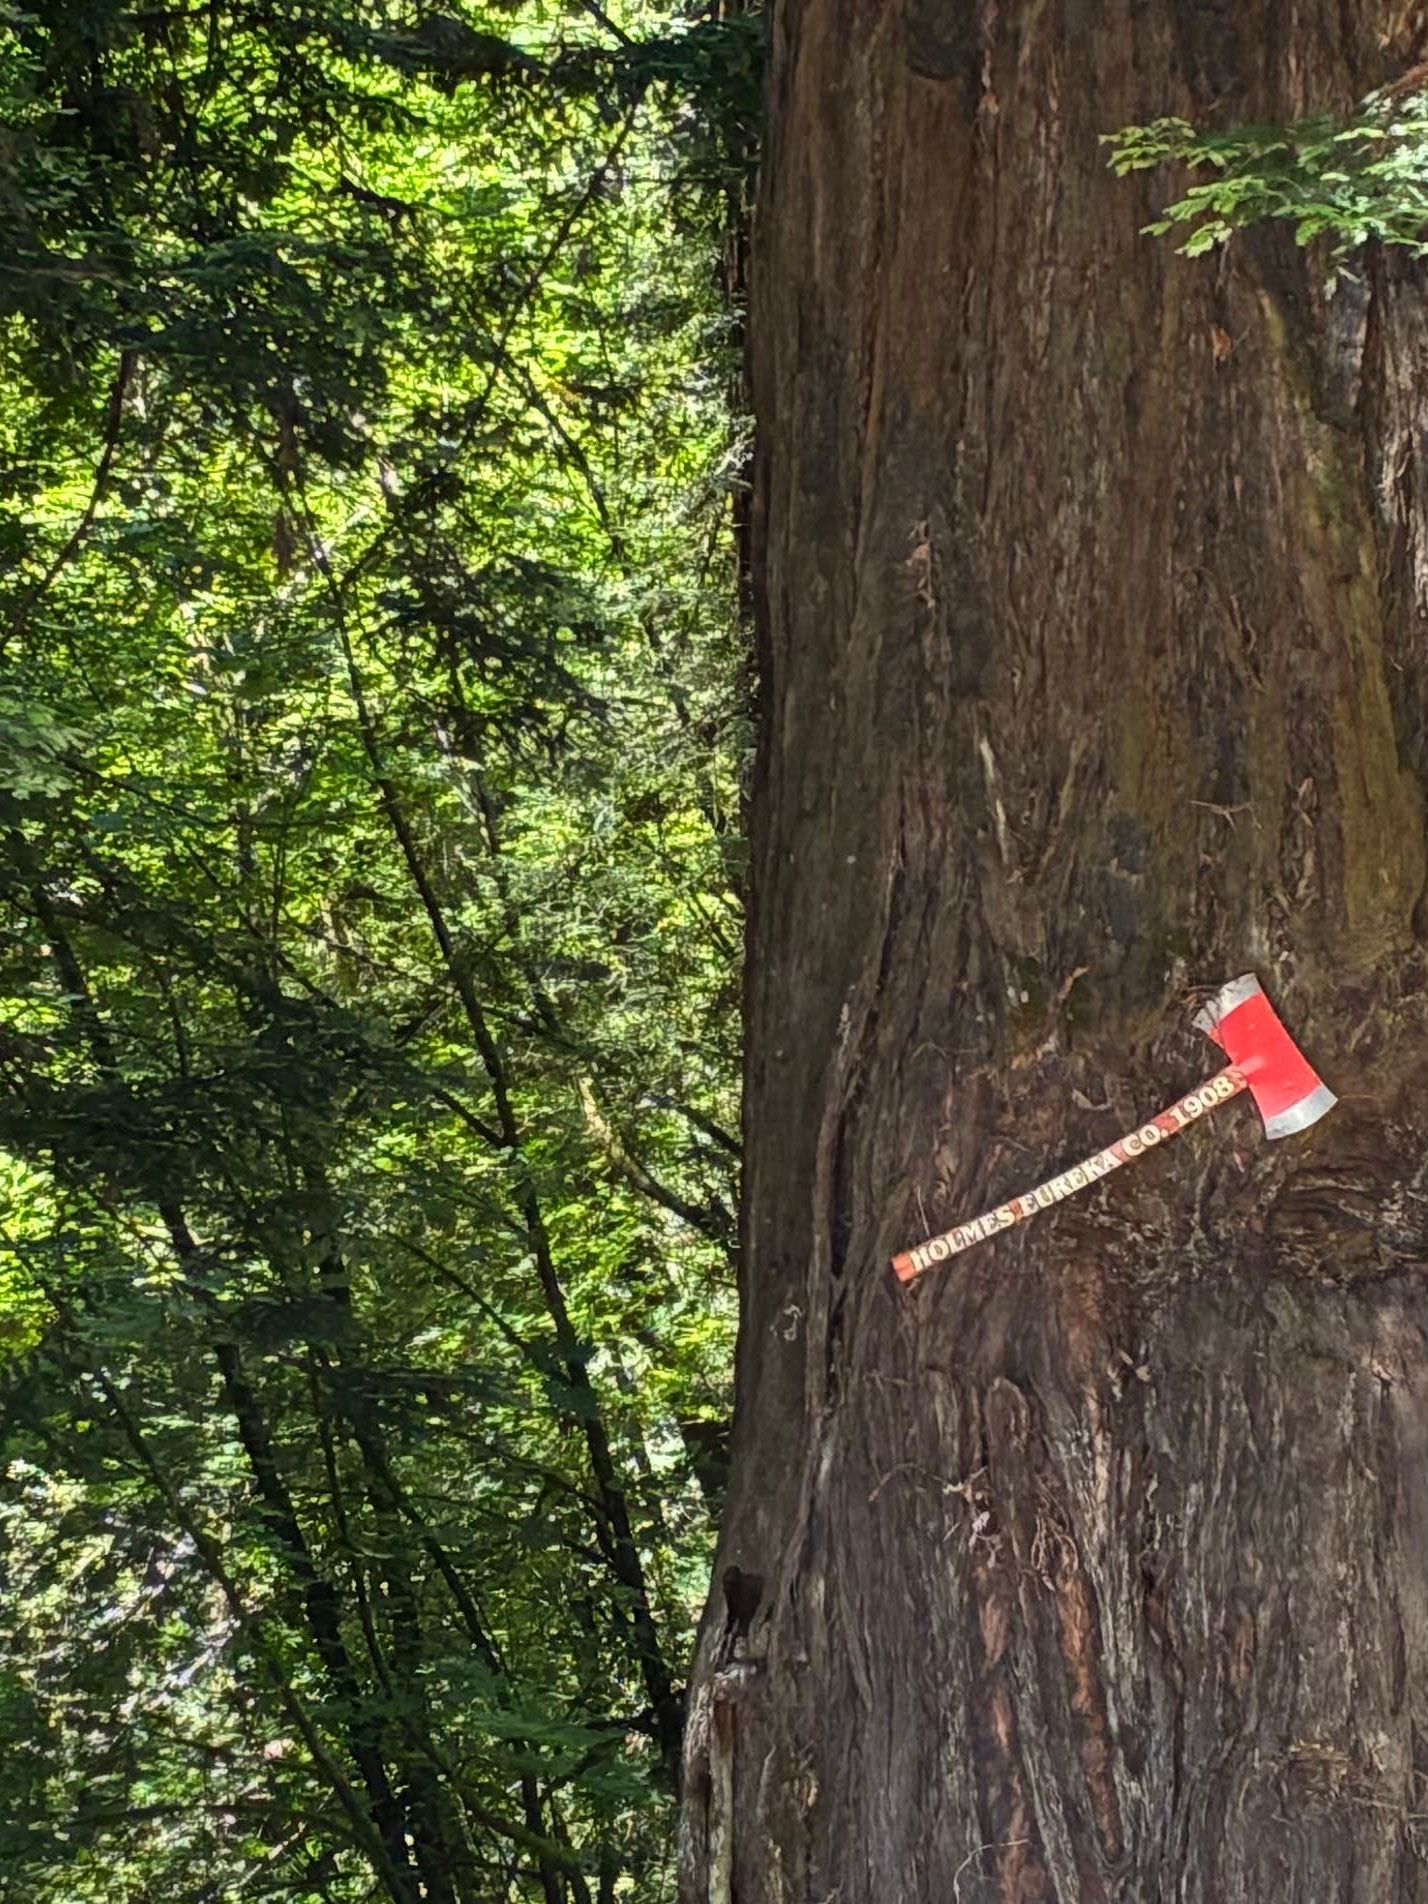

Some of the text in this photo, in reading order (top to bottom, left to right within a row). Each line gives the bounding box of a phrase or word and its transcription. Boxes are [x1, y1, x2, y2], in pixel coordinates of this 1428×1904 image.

[909, 1076, 1234, 1272] HOLMES EUREKA CO. 1908
